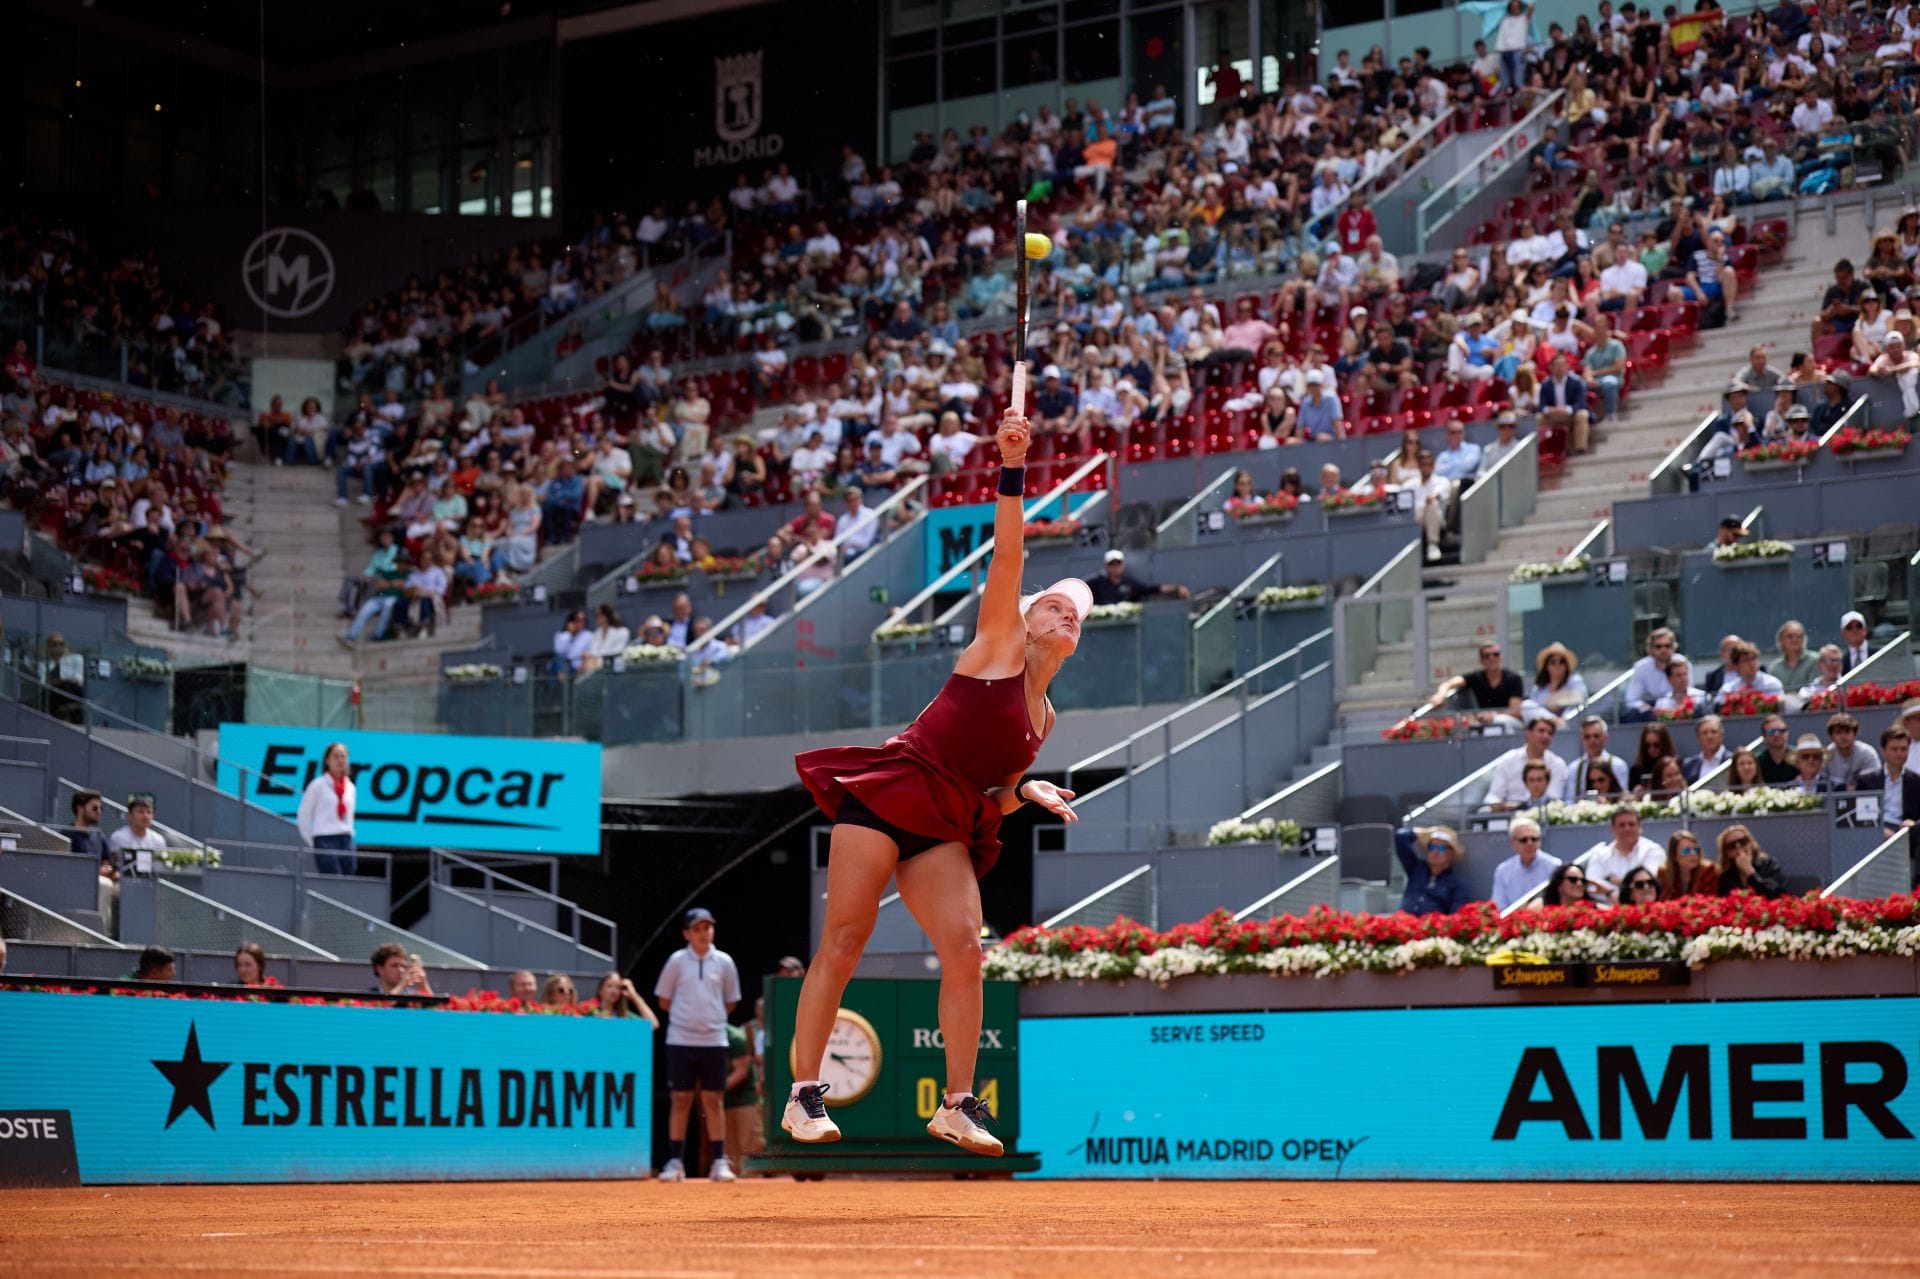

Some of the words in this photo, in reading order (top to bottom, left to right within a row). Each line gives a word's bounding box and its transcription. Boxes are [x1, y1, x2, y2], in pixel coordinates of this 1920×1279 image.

[694, 134, 784, 168] MADRID
[256, 745, 564, 822] Eropcar
[1502, 967, 1565, 985] Schweppes
[1595, 965, 1660, 984] Schweppes
[913, 1028, 1003, 1049] ROX
[1150, 1025, 1204, 1043] SERVE
[1210, 1024, 1265, 1041] SPEED
[242, 1062, 484, 1128] ESTRELLA
[498, 1069, 636, 1128] DAMM
[1491, 1040, 1917, 1140] AMER
[0, 1117, 58, 1139] OSTE
[1086, 1137, 1169, 1164] MUTUA
[1176, 1138, 1274, 1162] MADRID
[1282, 1138, 1353, 1161] OPEN
